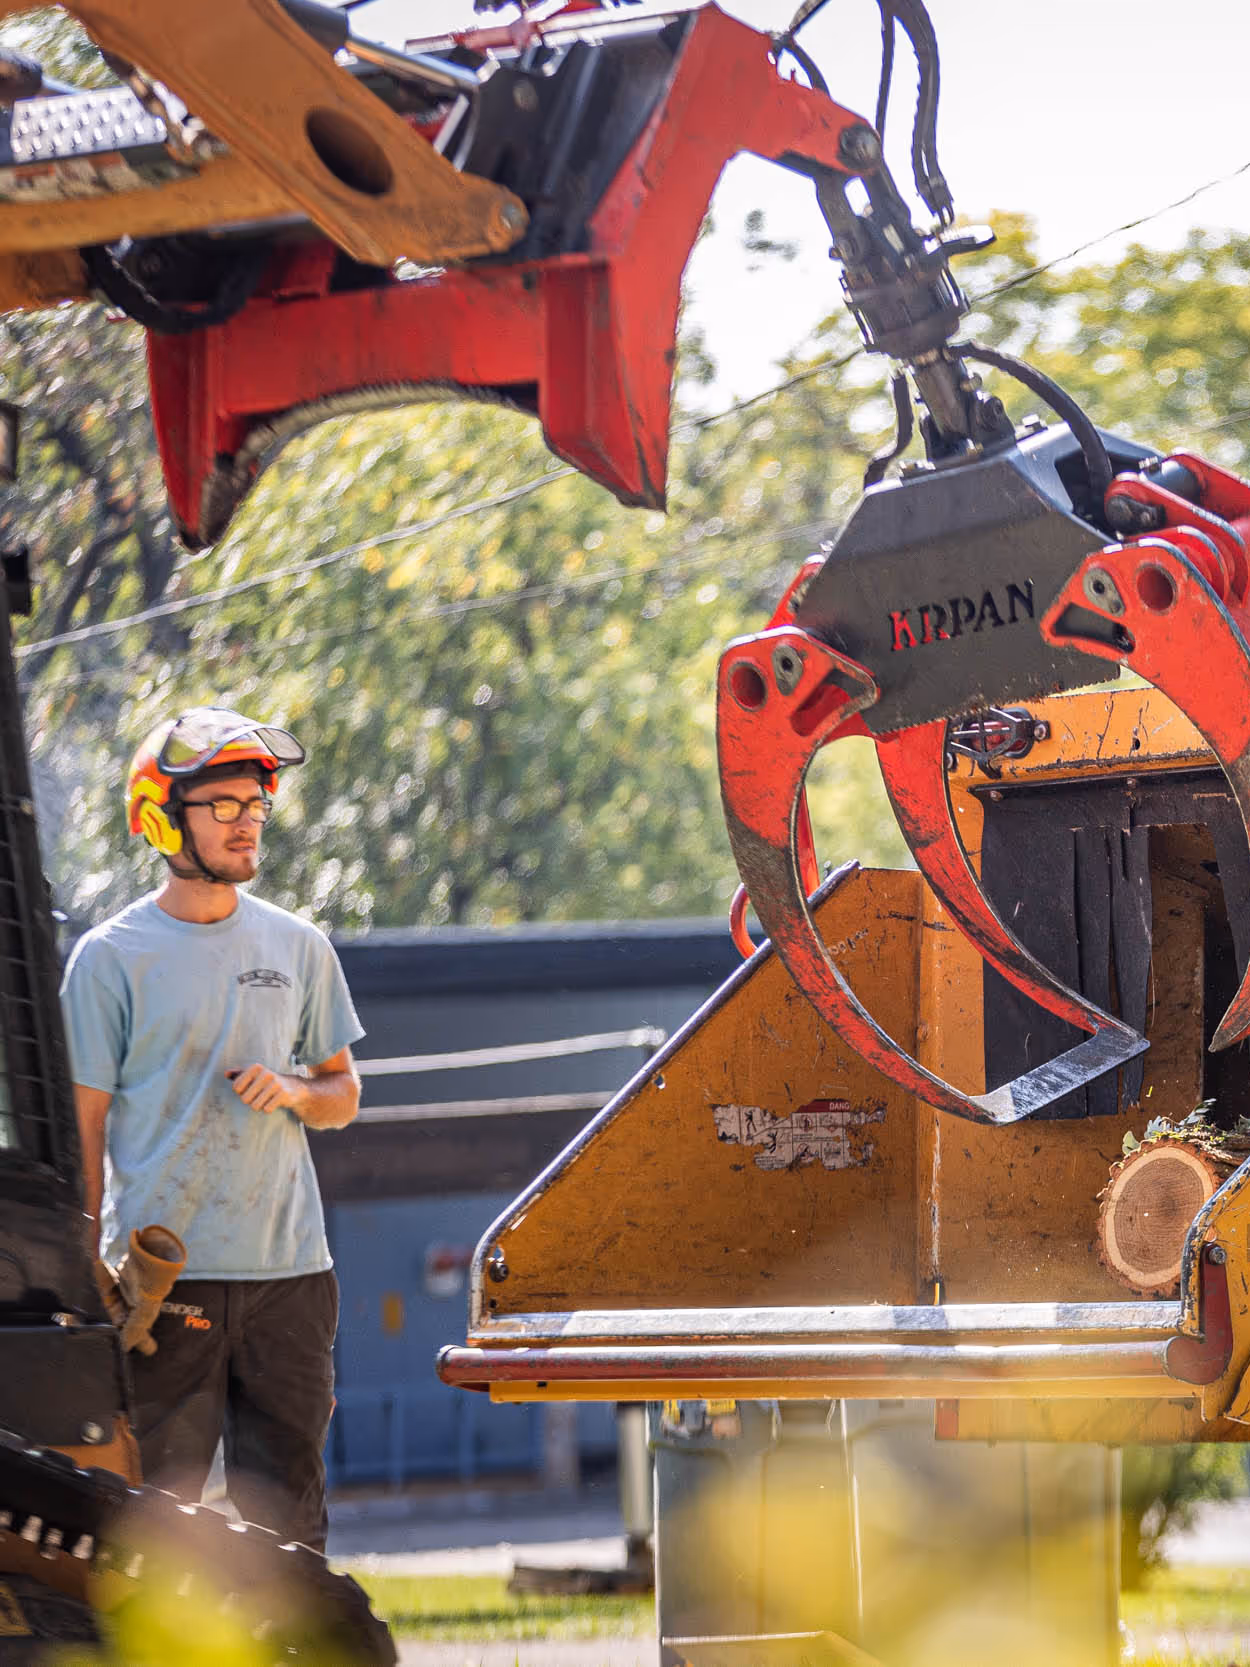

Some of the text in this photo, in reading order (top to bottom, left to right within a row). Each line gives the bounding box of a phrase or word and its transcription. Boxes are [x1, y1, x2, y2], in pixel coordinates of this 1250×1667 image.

[888, 577, 1035, 651] KRPAN
[829, 1102, 850, 1111] DANG
[184, 1315, 211, 1330] PRO
